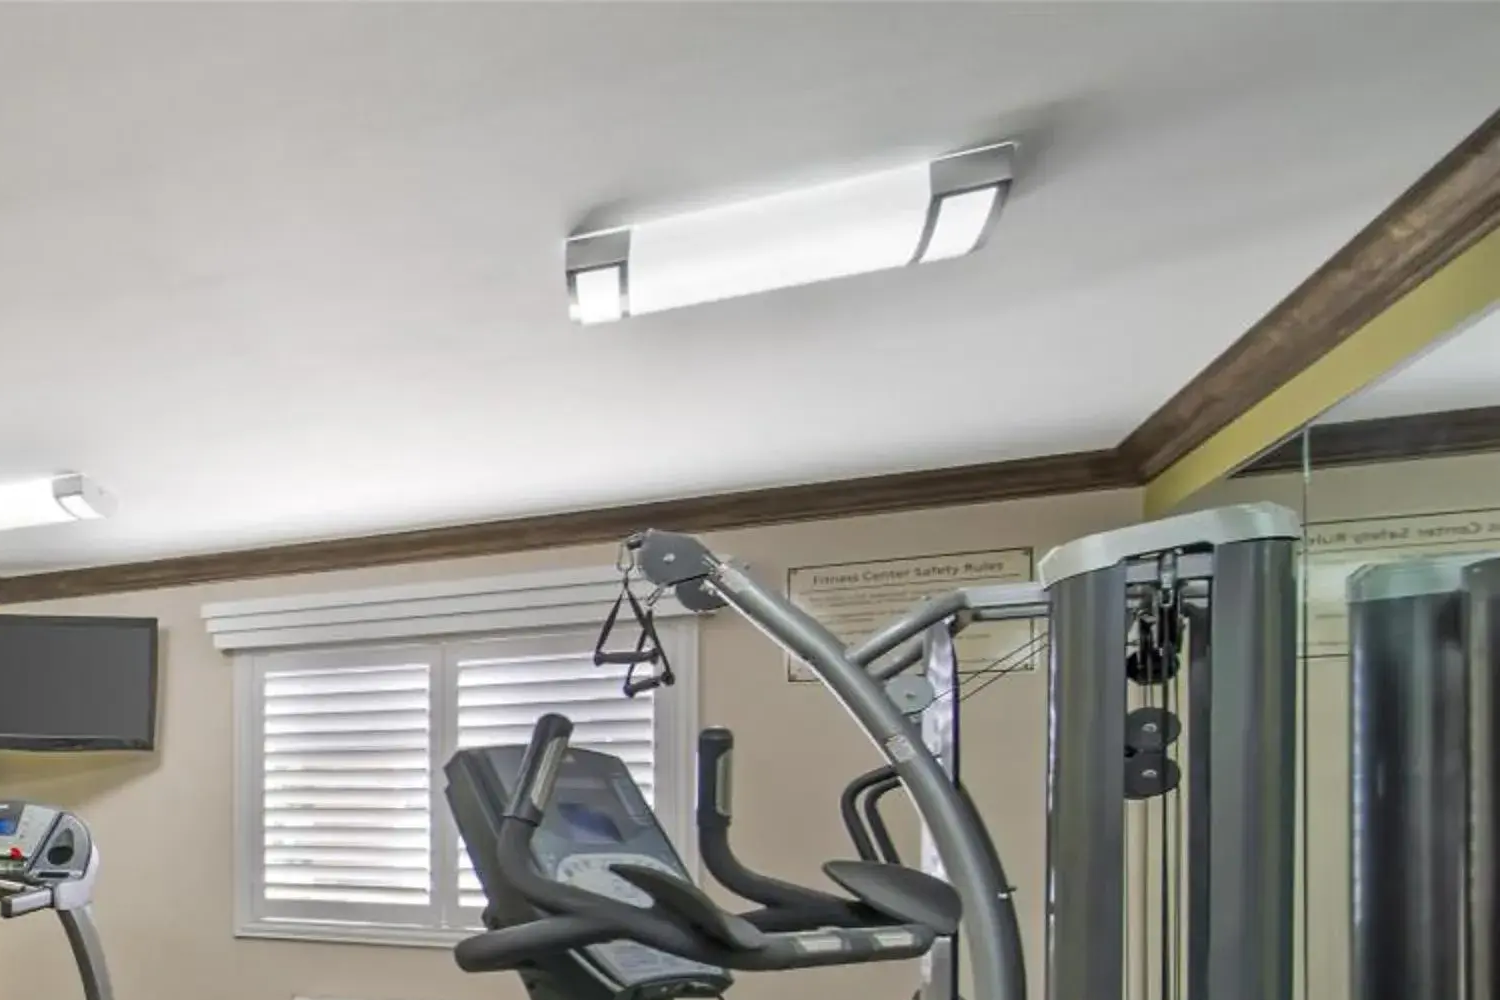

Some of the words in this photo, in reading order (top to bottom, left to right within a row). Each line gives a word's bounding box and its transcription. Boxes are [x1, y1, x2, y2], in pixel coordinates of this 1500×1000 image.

[862, 568, 910, 582] Center
[913, 564, 960, 578] Safety
[964, 560, 1005, 573] Rules
